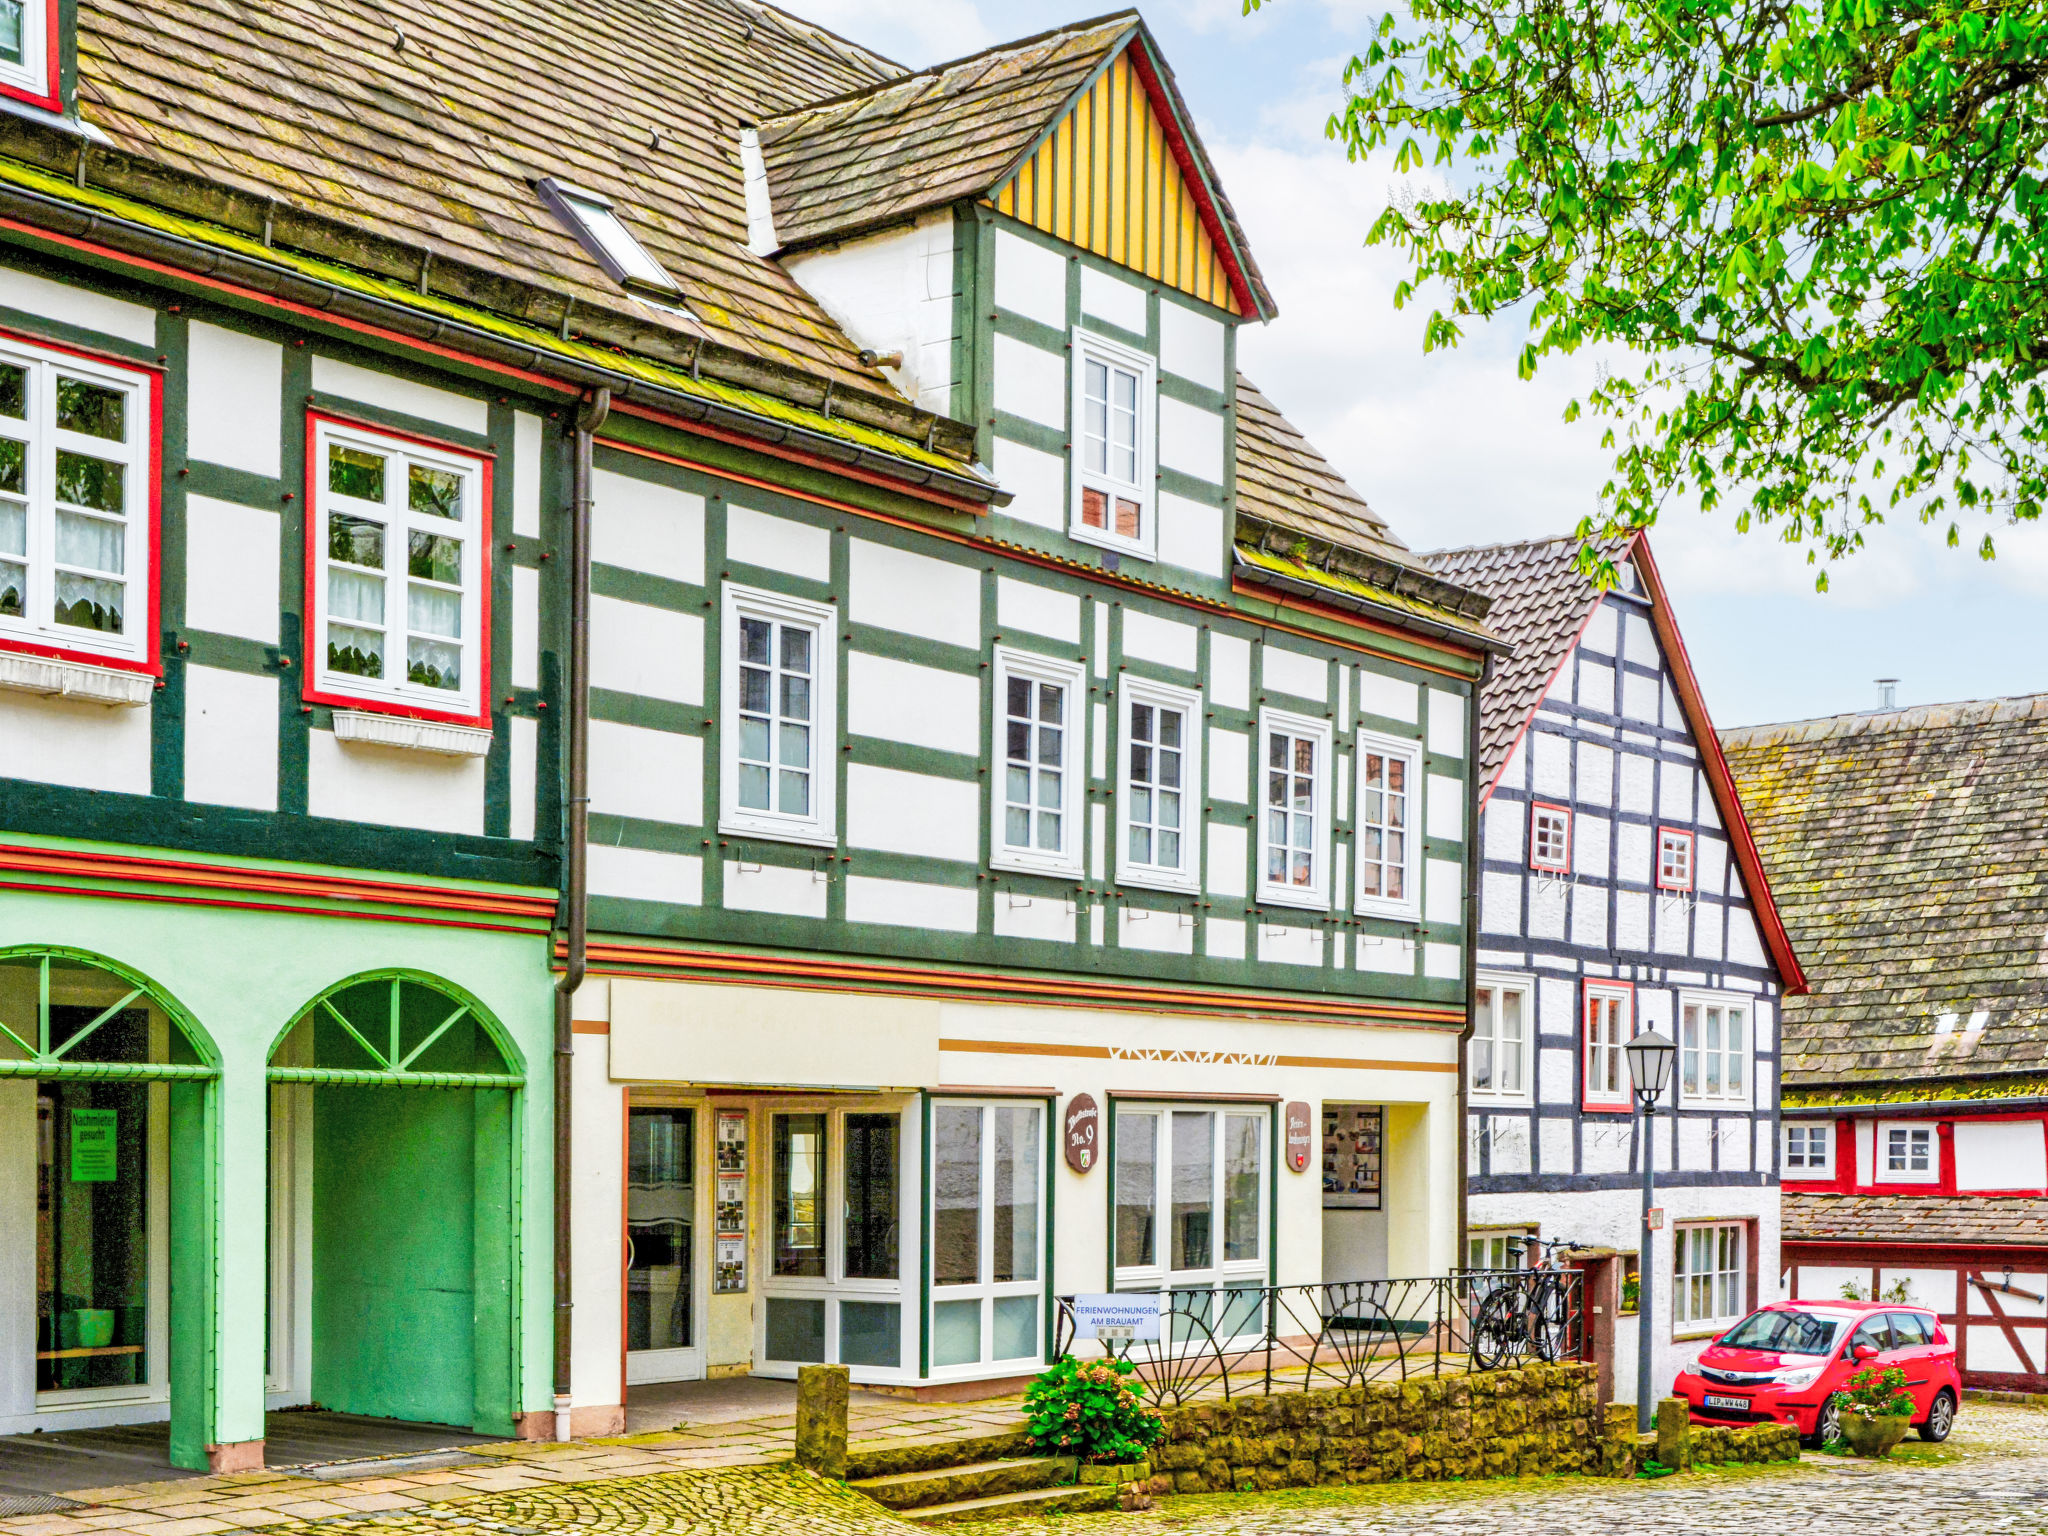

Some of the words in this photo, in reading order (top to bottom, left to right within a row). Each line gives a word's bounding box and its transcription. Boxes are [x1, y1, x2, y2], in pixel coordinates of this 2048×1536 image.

[73, 1112, 115, 1126] Nachmieter
[80, 1128, 105, 1142] gesucht
[1072, 1133, 1086, 1147] No.
[1086, 1124, 1094, 1145] 9
[1076, 1306, 1159, 1315] FERIENWOHNUNGEN
[1090, 1317, 1104, 1325] AM
[1106, 1317, 1144, 1326] BRAUAMT
